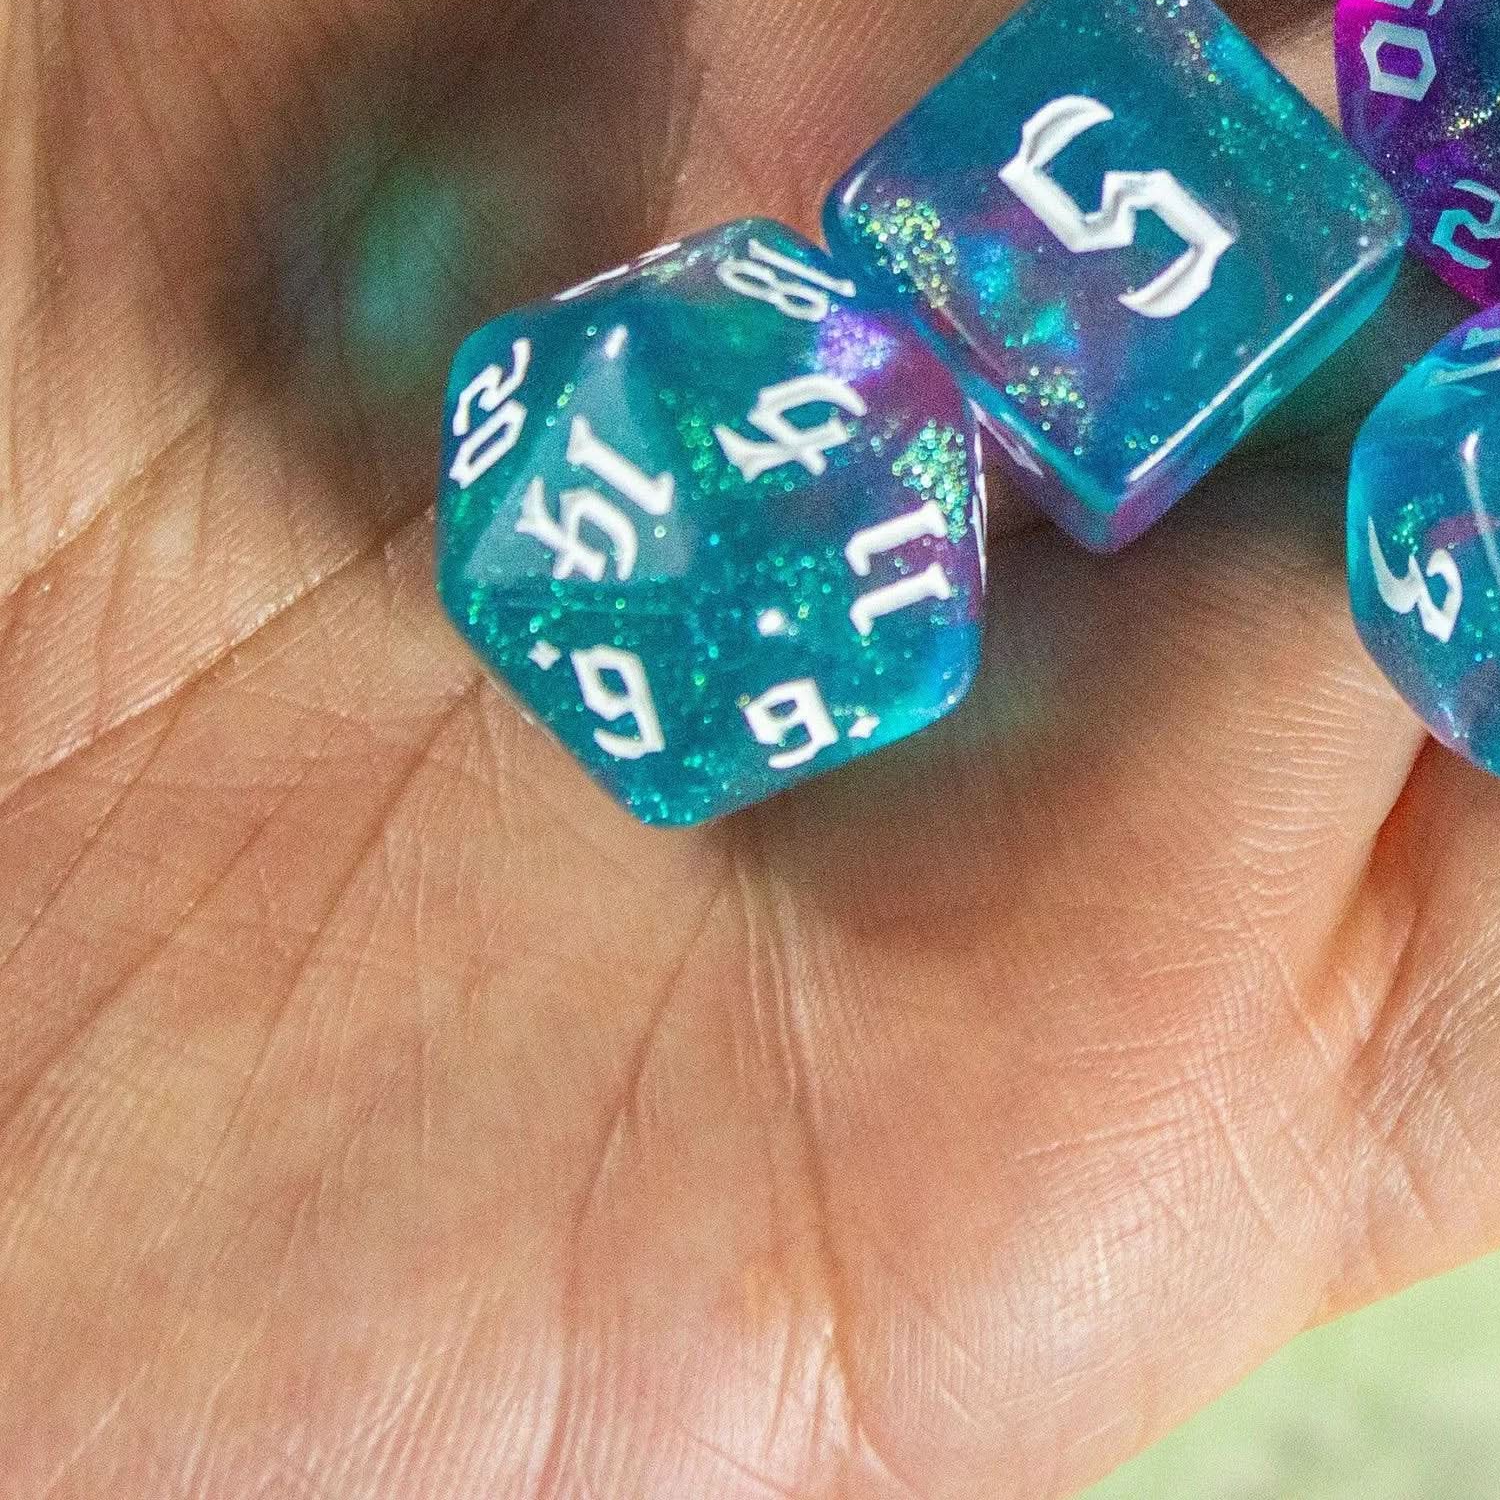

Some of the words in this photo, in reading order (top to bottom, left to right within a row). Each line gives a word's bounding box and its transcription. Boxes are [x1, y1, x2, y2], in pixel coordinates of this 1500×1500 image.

[999, 94, 1237, 319] 5
[716, 238, 857, 323] 18
[449, 338, 531, 490] 20
[515, 414, 676, 583] 14
[844, 500, 952, 637] 11
[1367, 515, 1463, 643] 3
